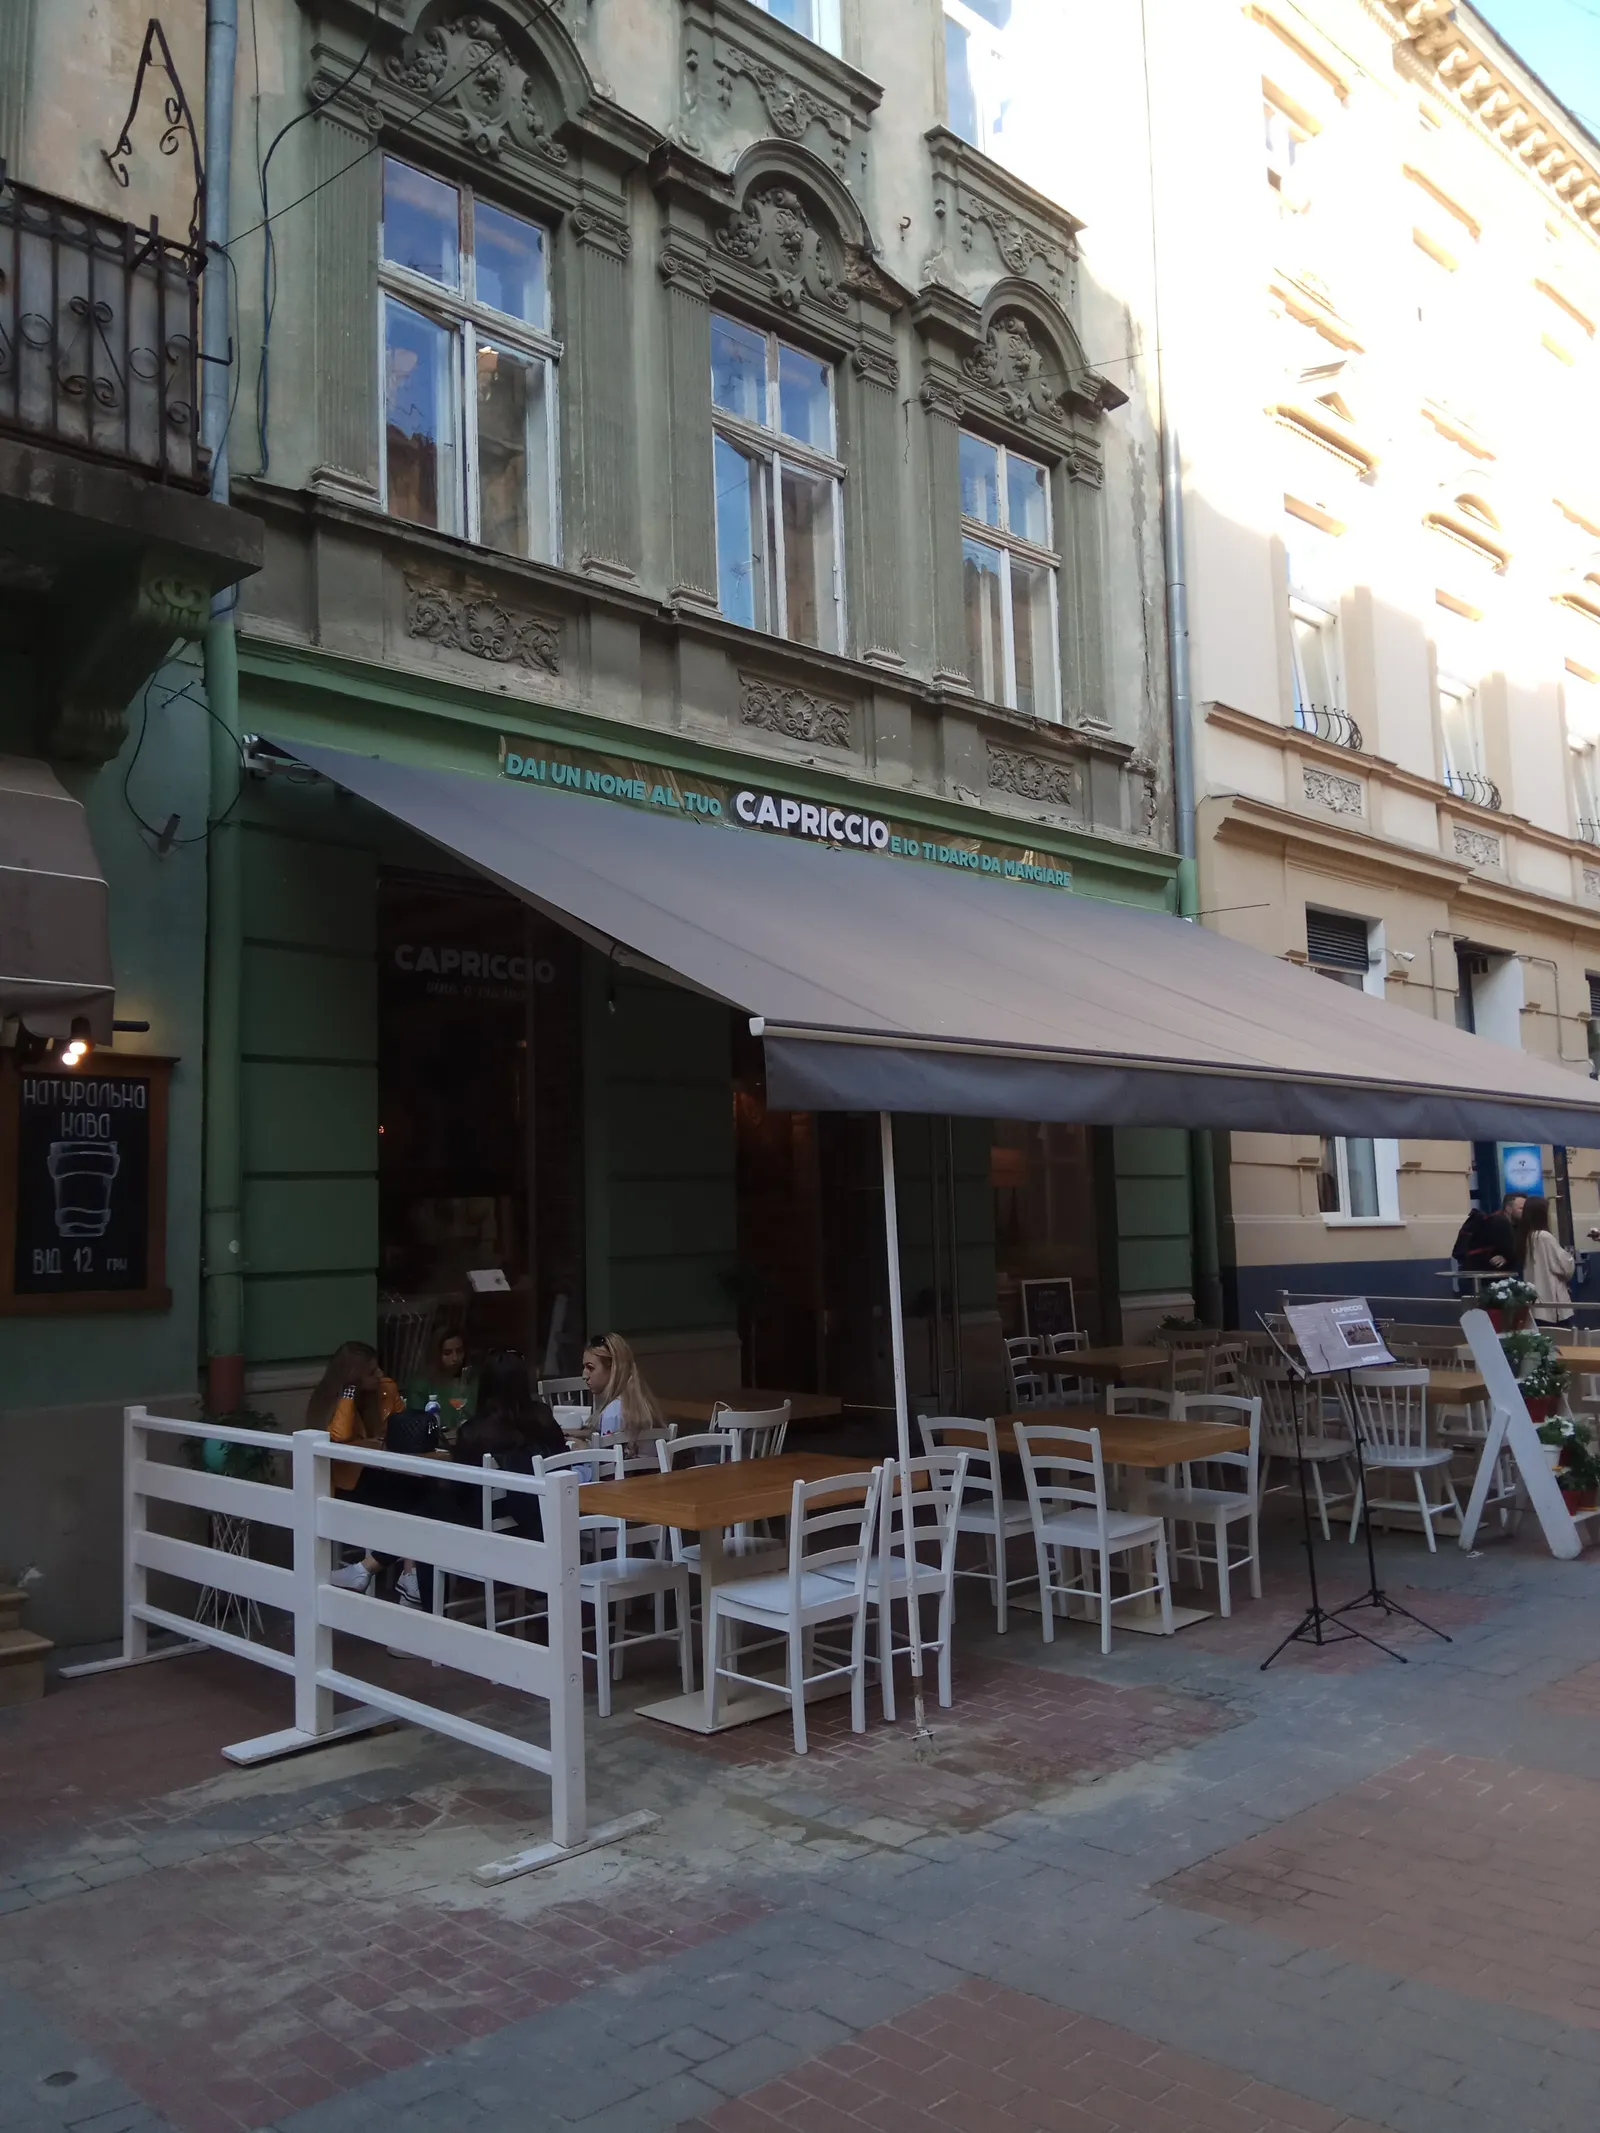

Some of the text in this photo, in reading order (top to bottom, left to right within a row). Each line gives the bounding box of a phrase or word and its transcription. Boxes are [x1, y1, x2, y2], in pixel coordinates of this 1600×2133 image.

[506, 753, 547, 781] DAI
[551, 762, 581, 788] UN
[585, 770, 646, 802] NOME
[650, 784, 680, 808] AL
[684, 791, 722, 817] TUO
[735, 791, 889, 848] CAPRICCIO
[922, 841, 937, 861] TI
[981, 854, 1001, 874] DA
[1003, 859, 1072, 888] MANGIARE
[395, 944, 556, 983] CAPRICCIO
[73, 1246, 94, 1273] 12
